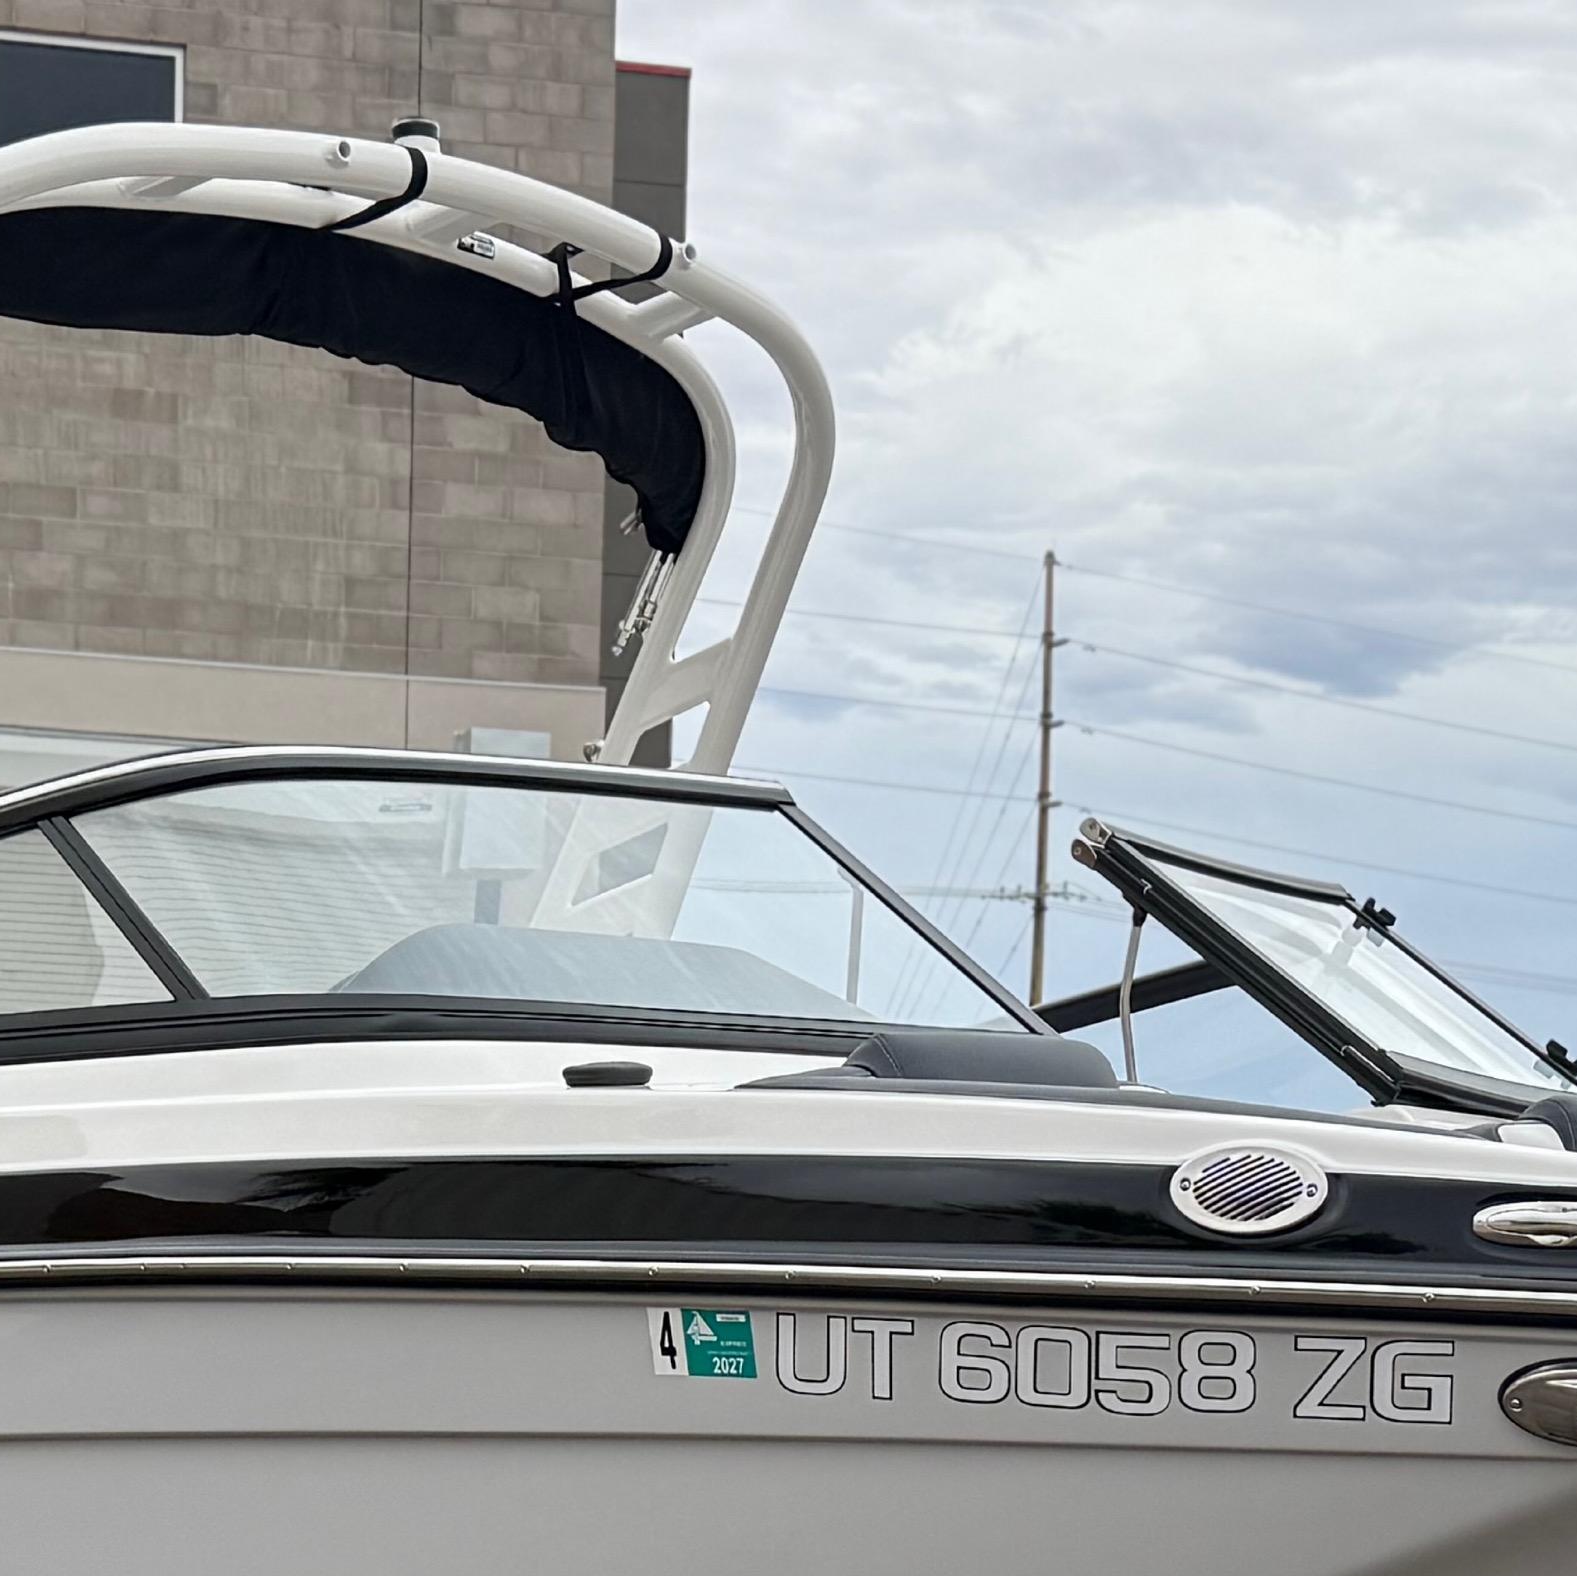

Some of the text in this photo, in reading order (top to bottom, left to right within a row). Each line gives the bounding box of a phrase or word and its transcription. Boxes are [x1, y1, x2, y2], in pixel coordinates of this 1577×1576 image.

[659, 1310, 678, 1370] 4
[711, 1356, 745, 1375] 2027
[774, 1312, 1455, 1426] UT 6058 ZG
